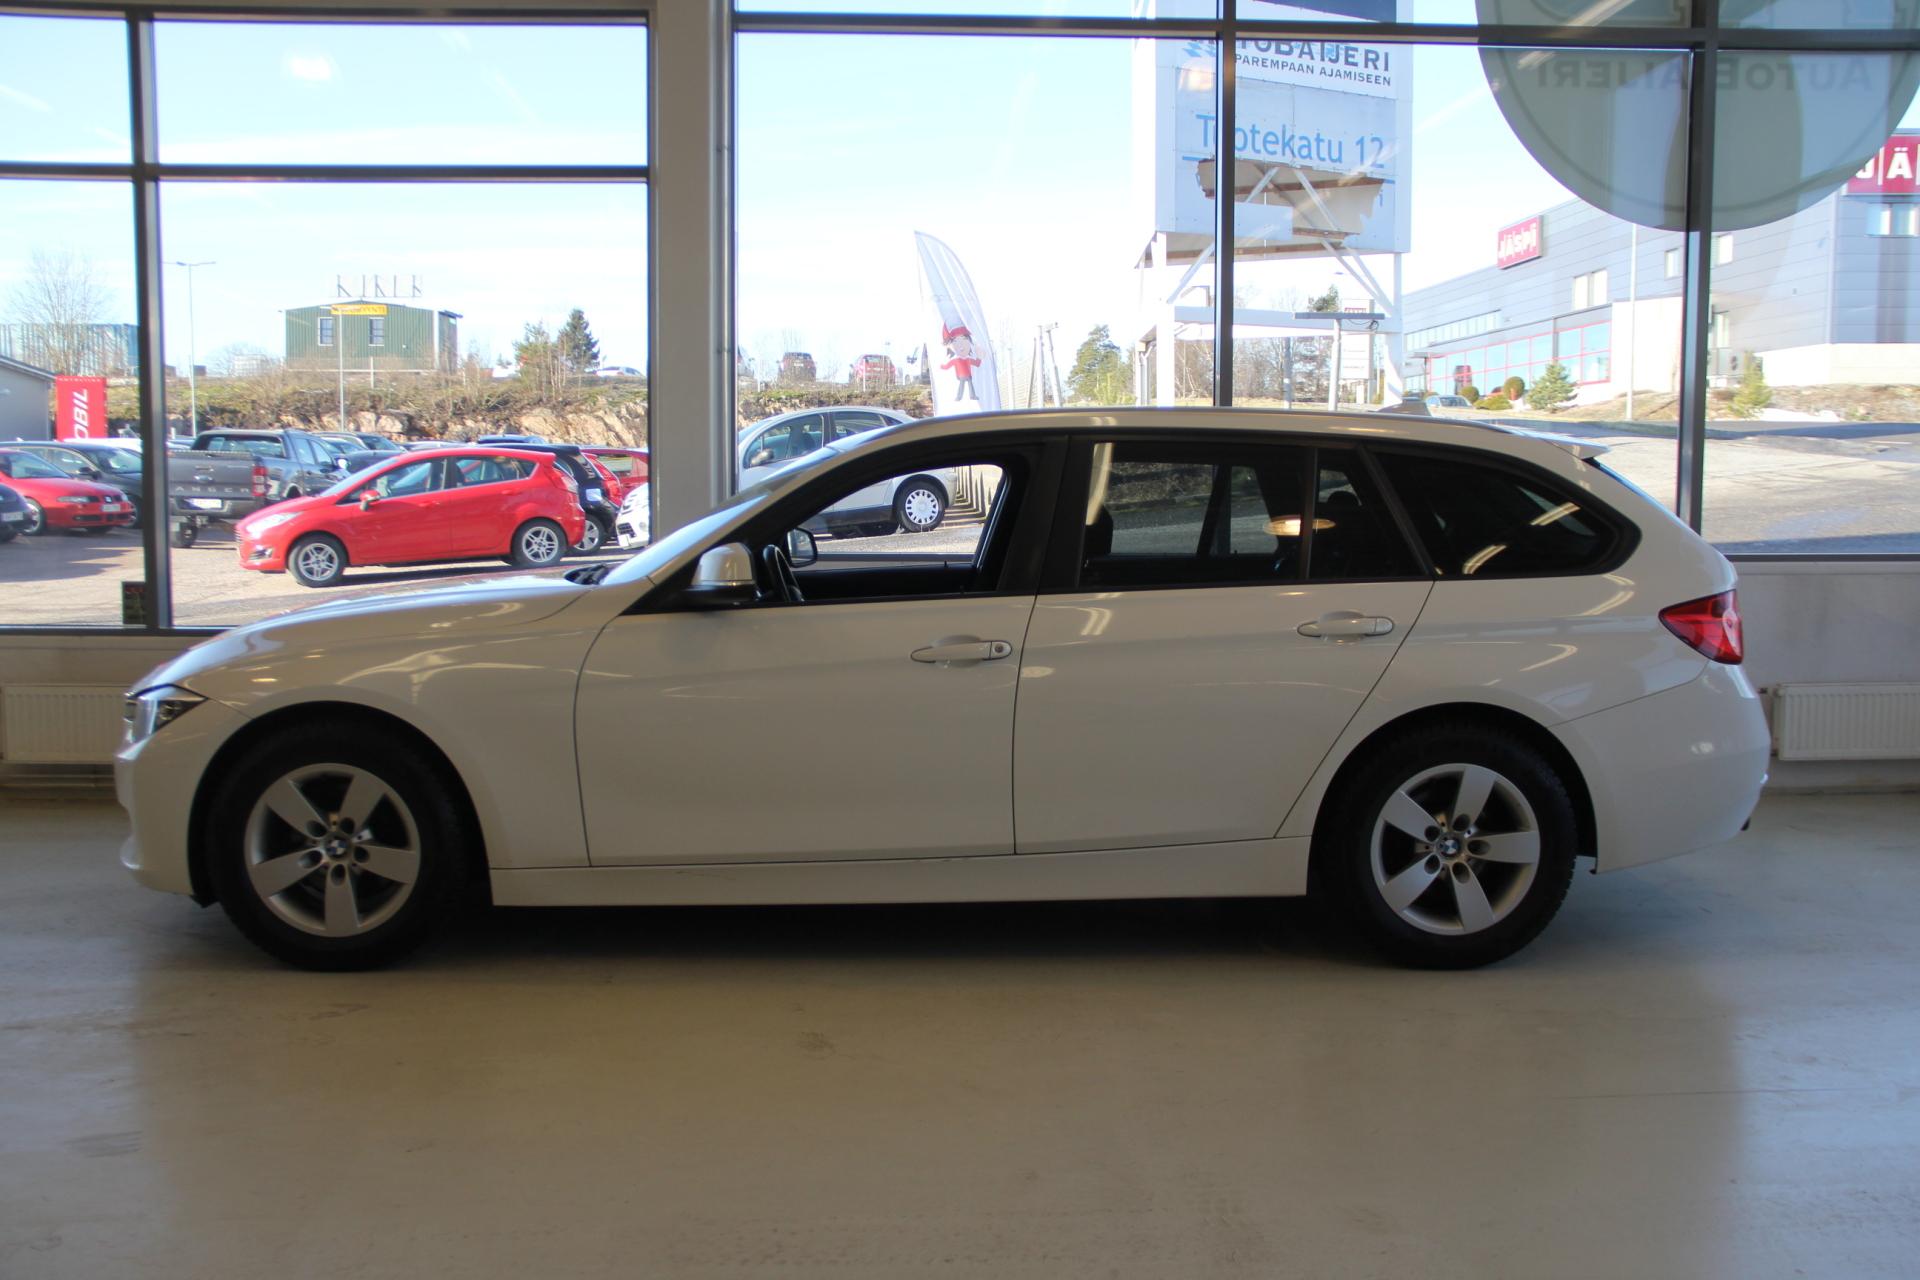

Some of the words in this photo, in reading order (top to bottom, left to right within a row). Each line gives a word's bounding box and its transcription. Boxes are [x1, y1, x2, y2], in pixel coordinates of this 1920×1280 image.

[1235, 53, 1314, 74] PAREMPAAN
[1319, 66, 1391, 86] AJAMISEEN
[1196, 114, 1343, 163] Totekatu
[1355, 135, 1385, 168] 12
